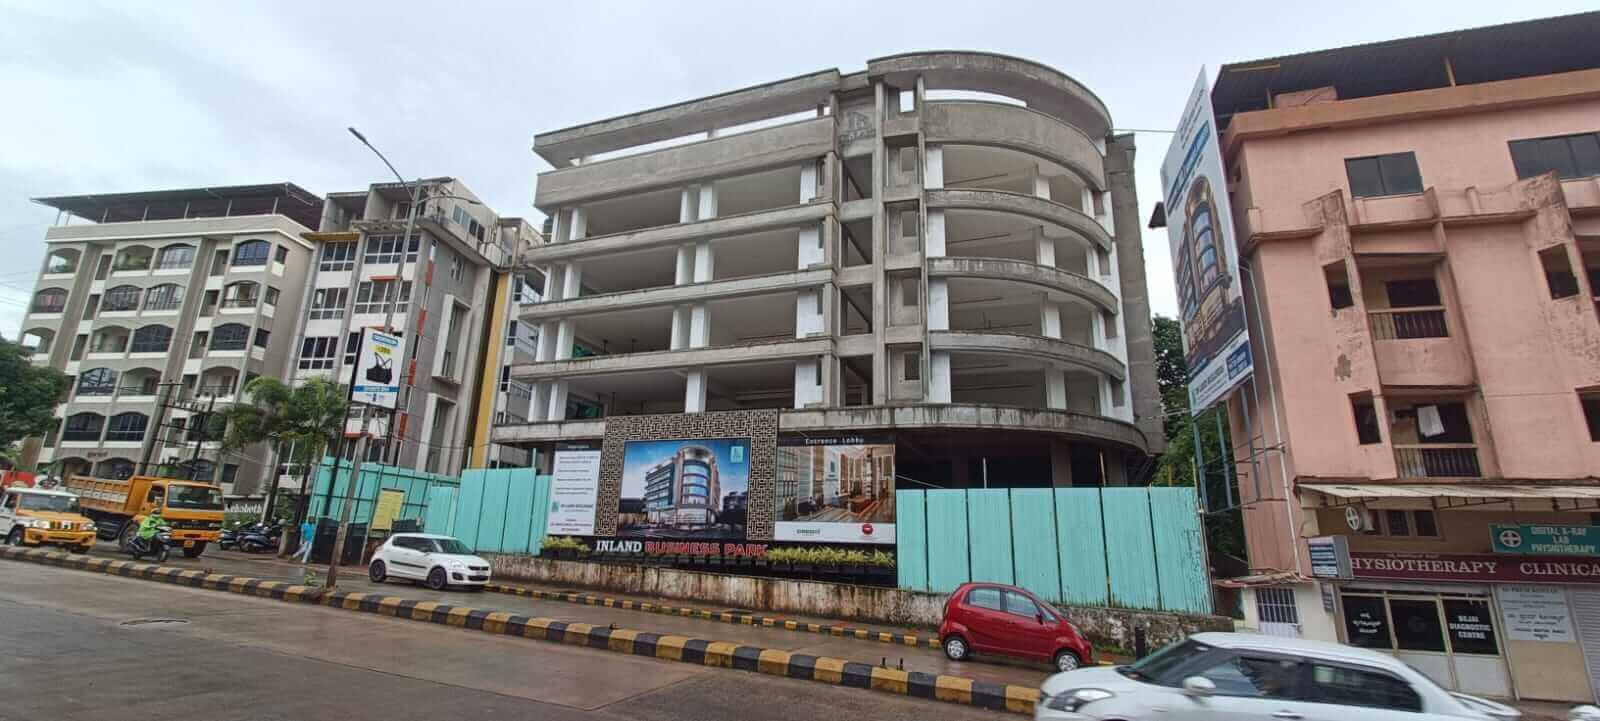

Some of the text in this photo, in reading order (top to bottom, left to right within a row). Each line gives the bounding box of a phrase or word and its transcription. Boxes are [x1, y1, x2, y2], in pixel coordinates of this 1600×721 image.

[595, 540, 768, 557] INLAND BUSINESS PARK
[1553, 536, 1570, 544] LAB
[1351, 557, 1497, 574] HYSIOTHERAPY
